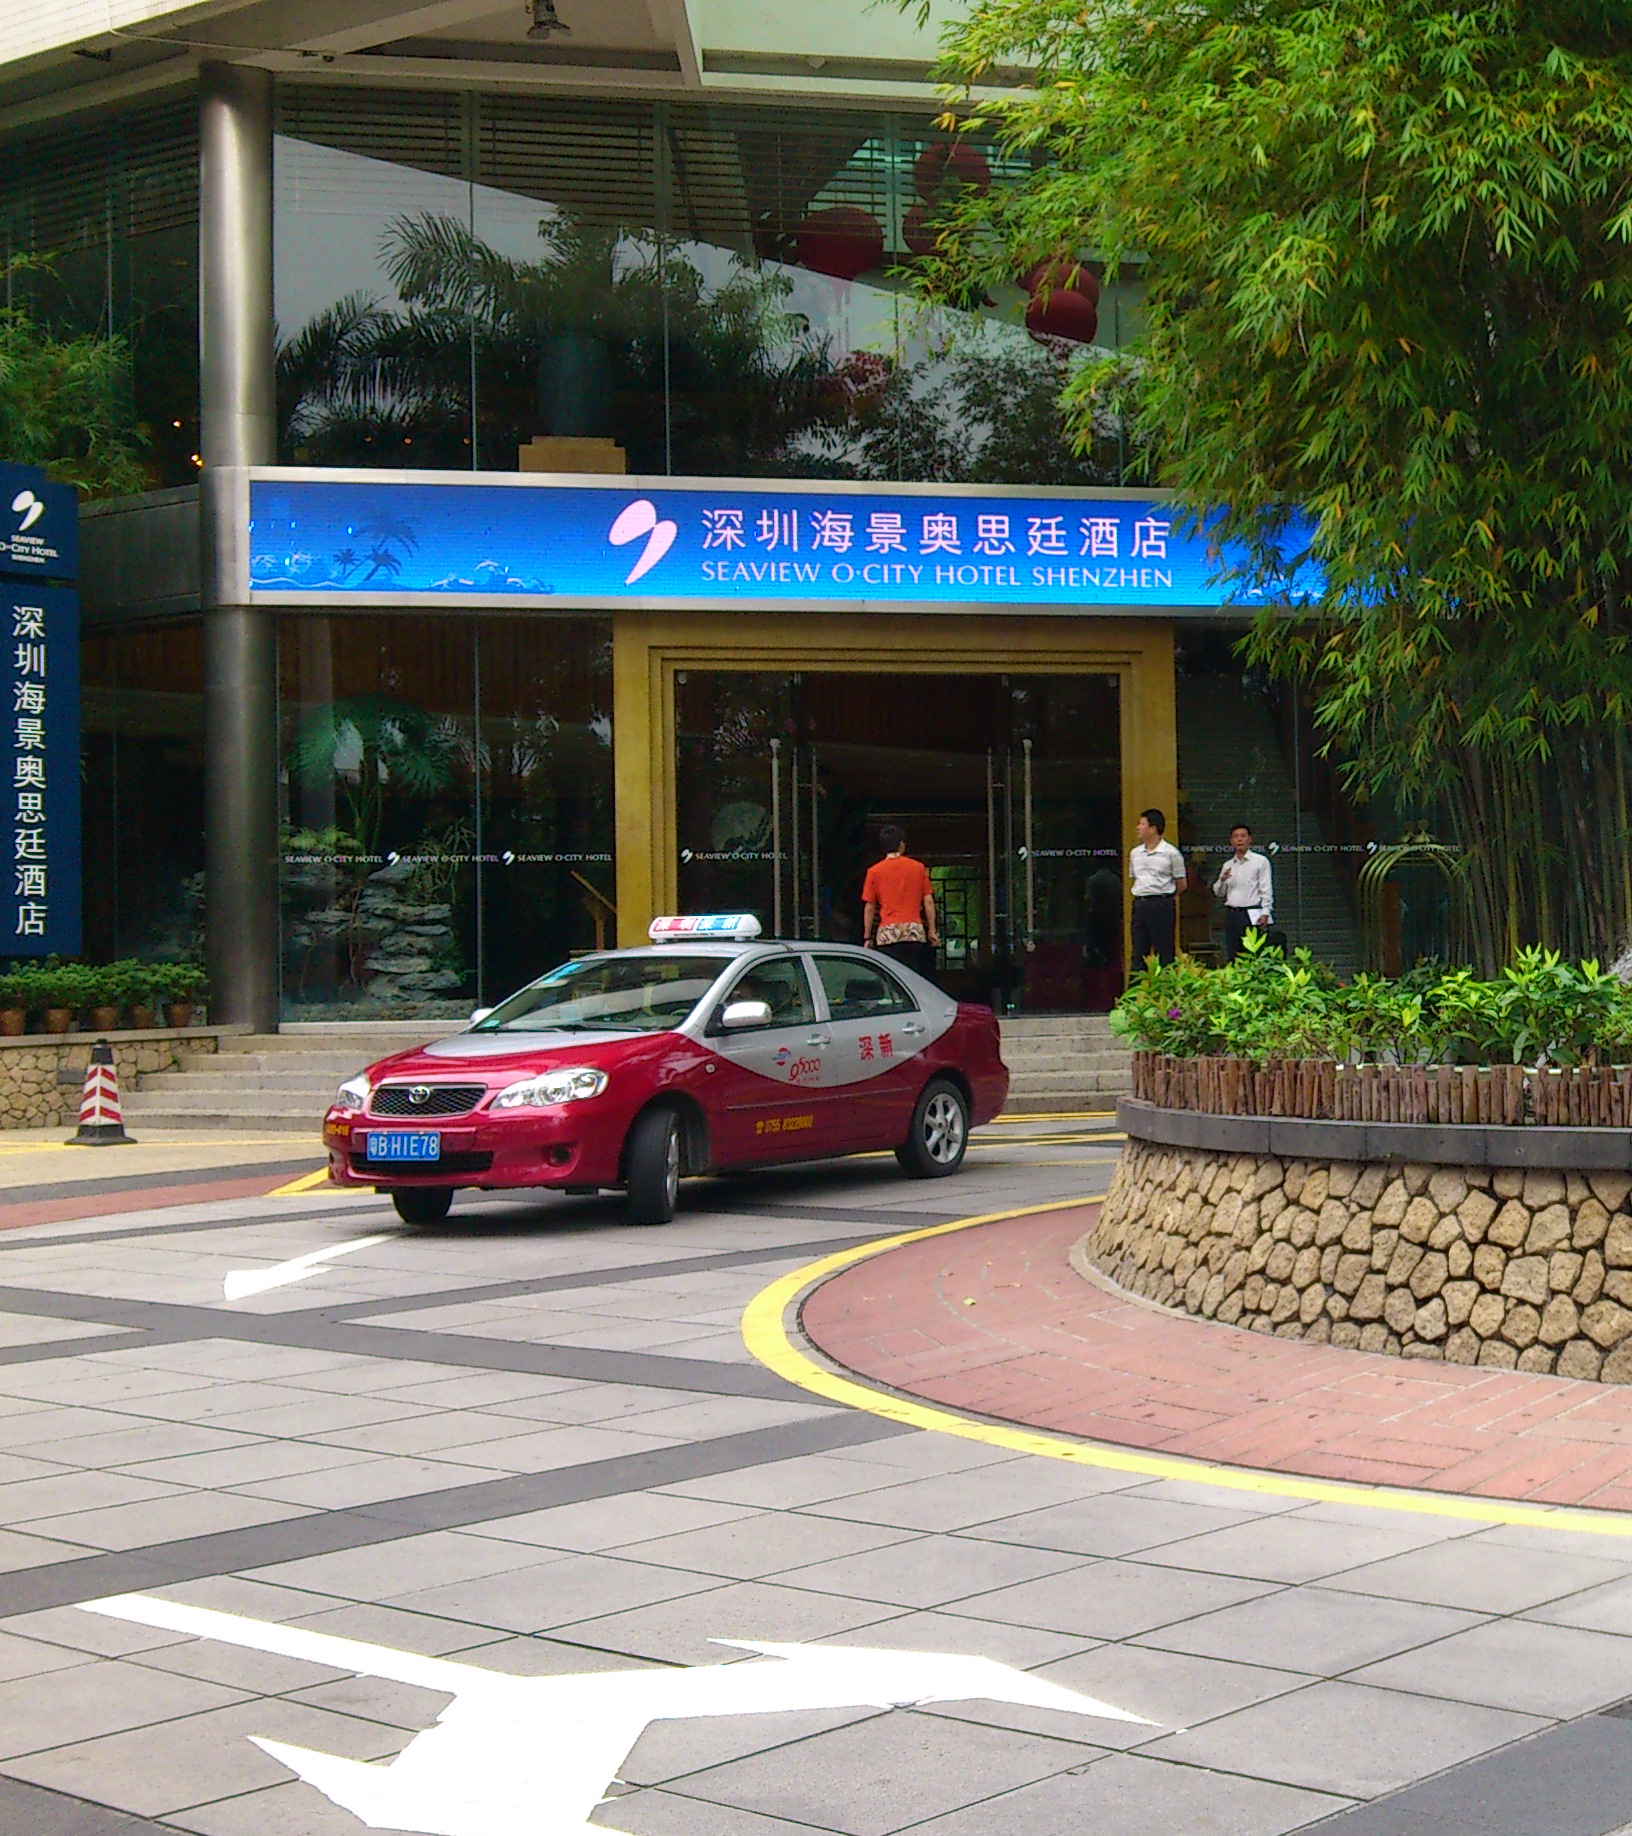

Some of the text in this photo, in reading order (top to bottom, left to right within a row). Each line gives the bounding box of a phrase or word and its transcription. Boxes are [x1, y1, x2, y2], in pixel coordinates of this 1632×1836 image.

[701, 508, 1170, 559] 深圳海景奥思廷酒店
[701, 560, 821, 583] SEAVIEW
[935, 564, 1022, 587] HOTEL
[1032, 566, 1173, 588] SHENZHEN
[12, 604, 47, 936] 深圳海景奥思廷酒店
[355, 855, 383, 863] HOTEL
[517, 854, 553, 862] SEAVIEW
[585, 854, 613, 862] HOTEL
